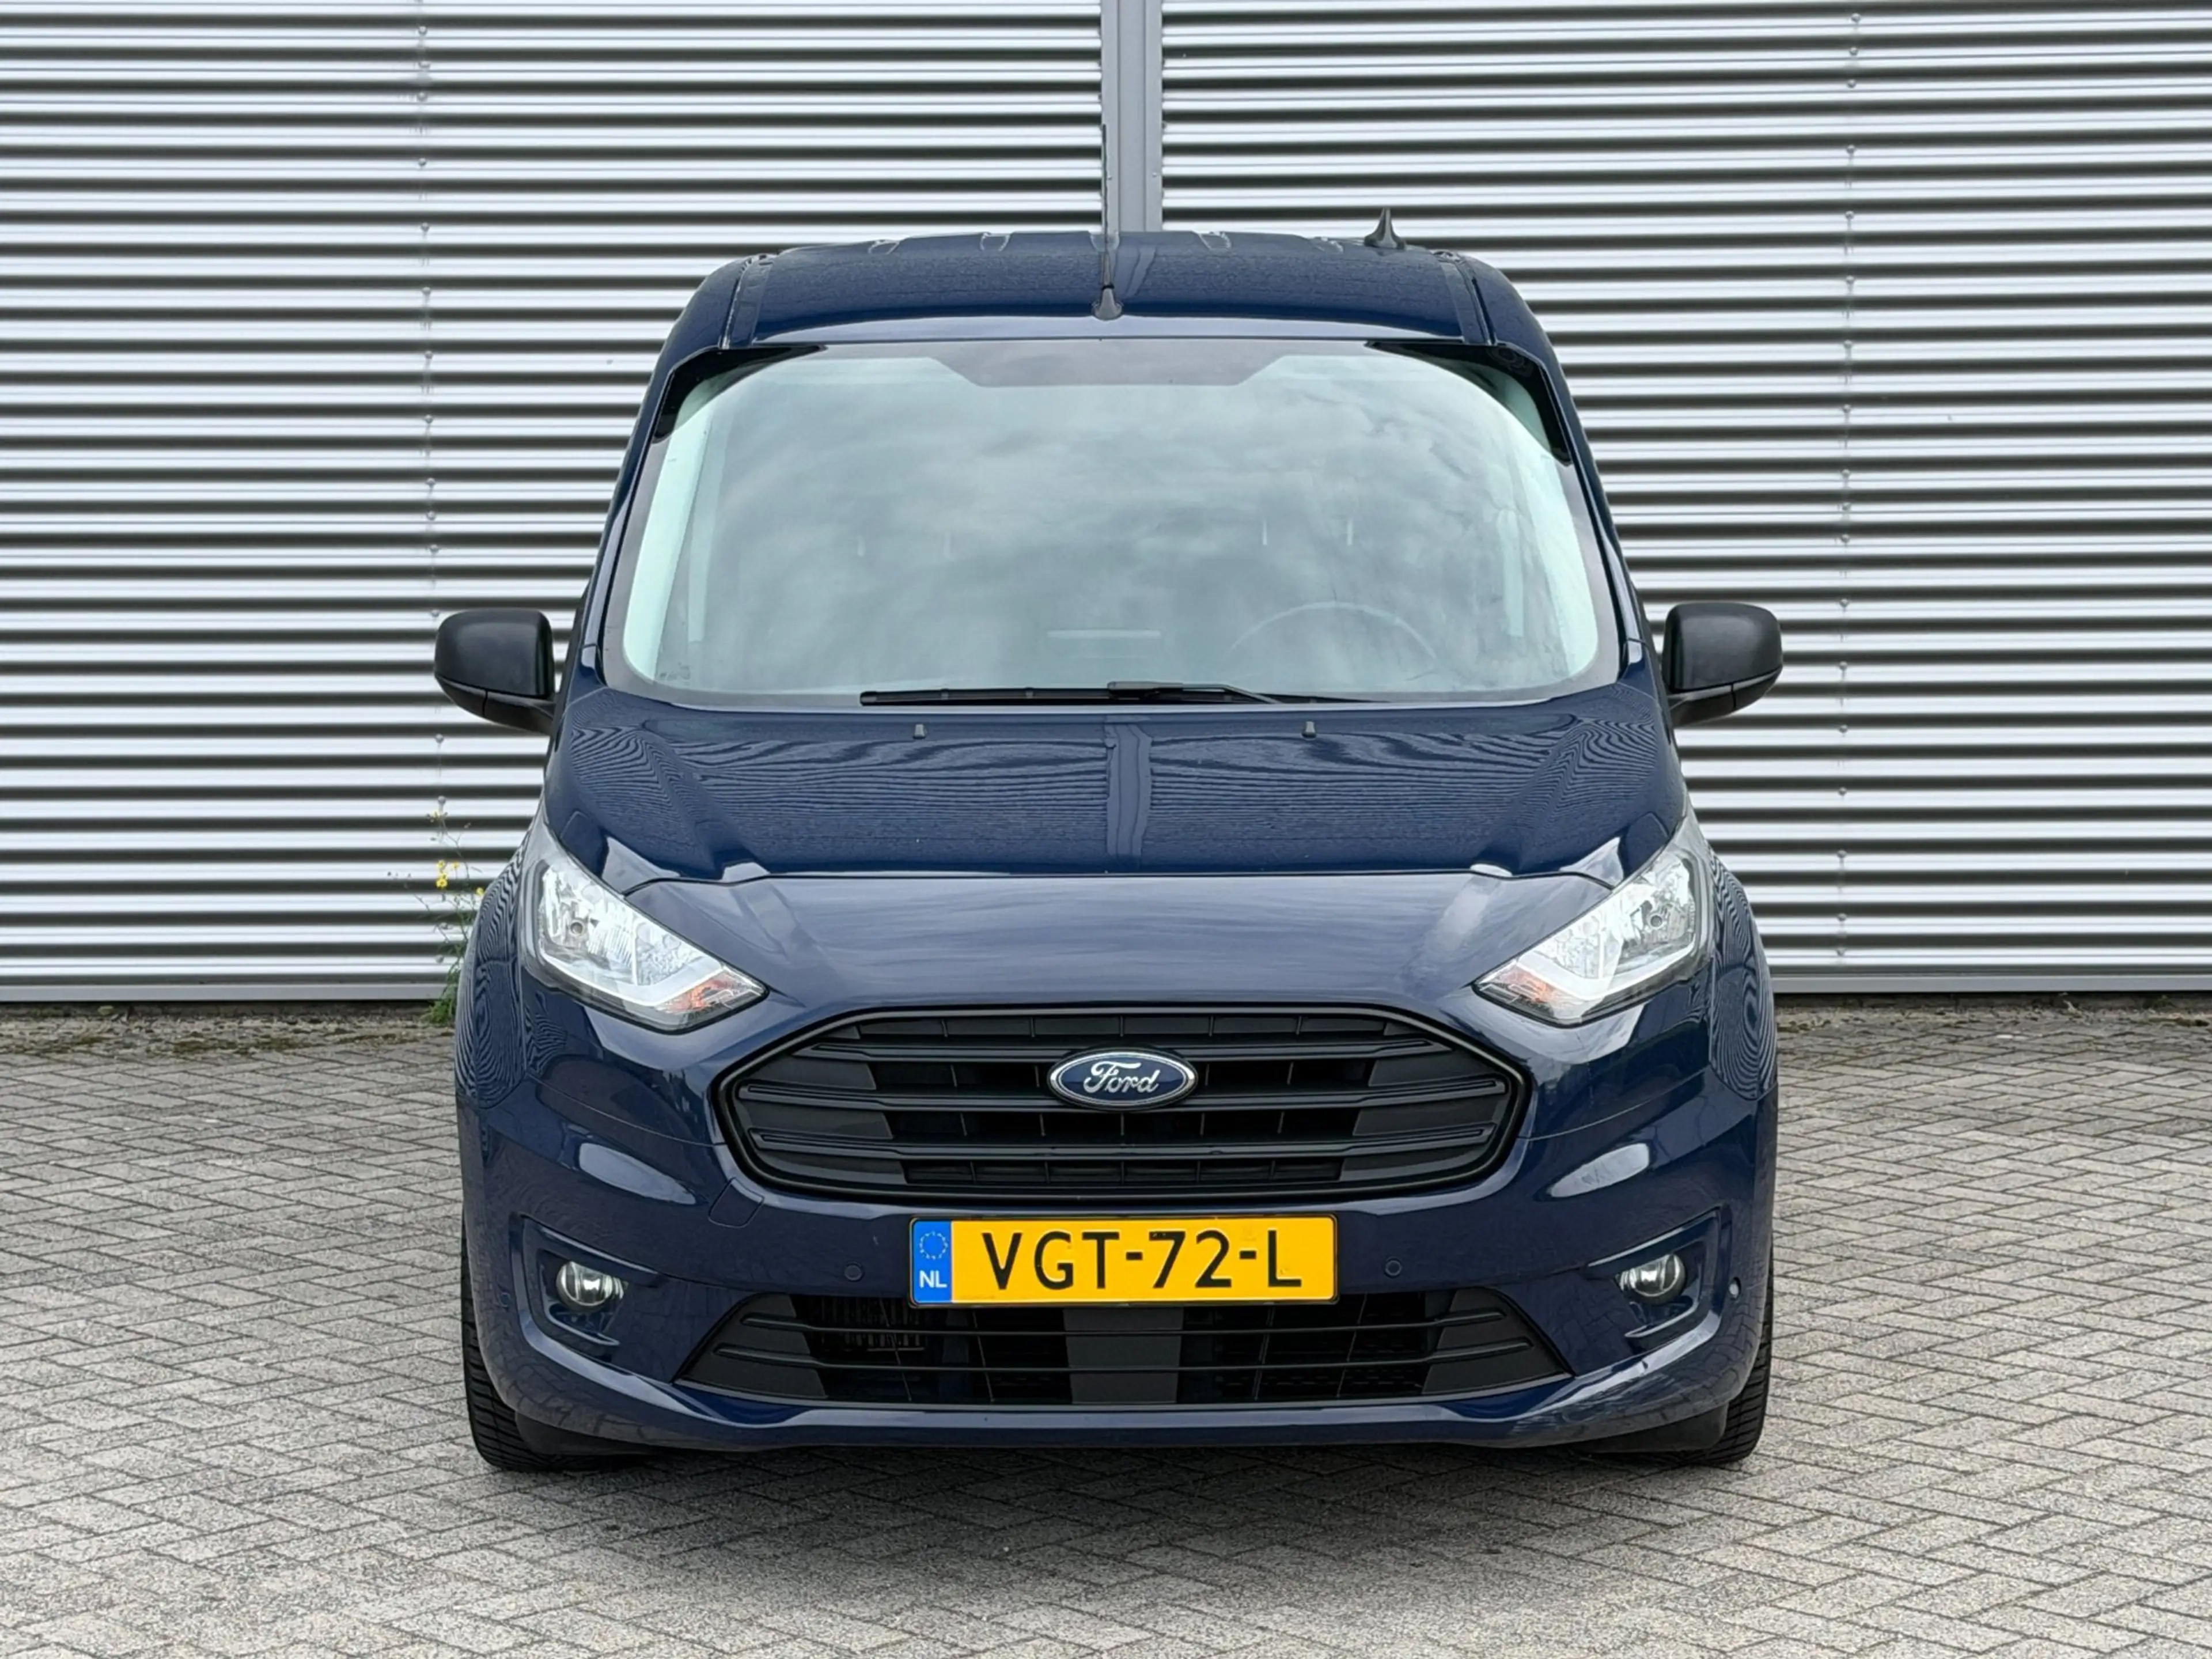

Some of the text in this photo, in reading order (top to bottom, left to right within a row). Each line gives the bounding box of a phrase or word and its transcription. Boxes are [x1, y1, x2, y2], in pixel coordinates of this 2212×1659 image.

[1084, 1061, 1160, 1092] Ford
[982, 1230, 1302, 1290] VGT-72-L
[920, 1271, 946, 1288] NL
